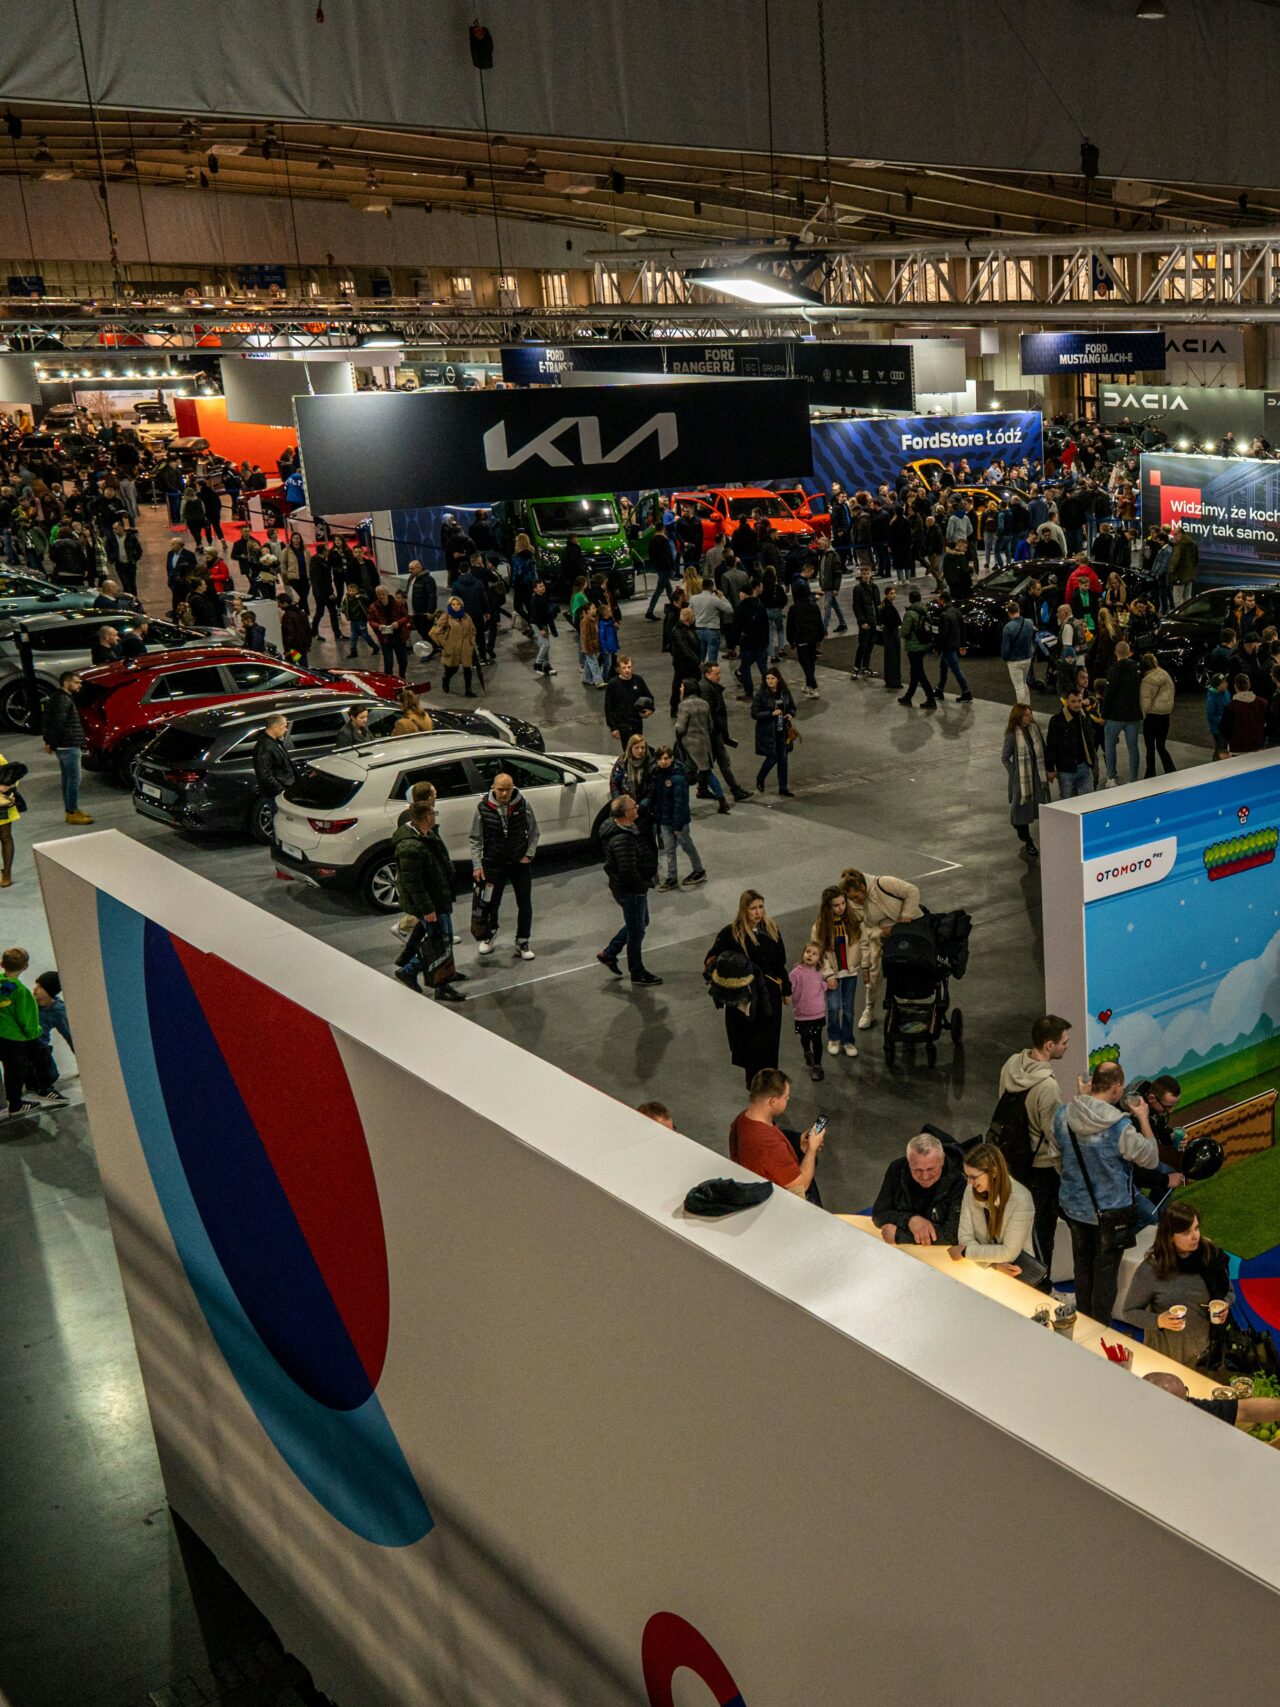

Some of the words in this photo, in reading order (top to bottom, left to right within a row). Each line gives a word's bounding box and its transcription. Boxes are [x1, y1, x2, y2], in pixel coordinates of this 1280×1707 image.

[1085, 343, 1108, 354] FORD
[1165, 338, 1227, 354] ACIA
[546, 349, 565, 361] FORD
[1059, 352, 1100, 365] MUSTANG
[1101, 351, 1133, 364] MACH-E
[538, 360, 574, 374] E-TRANST
[673, 361, 721, 374] RANGER
[1103, 391, 1189, 411] DACIA
[902, 431, 984, 451] FordStore
[986, 427, 1022, 445] Łódź
[1170, 499, 1229, 520] Widzimy,
[1230, 505, 1247, 519] że
[1171, 519, 1209, 538] Mamy
[1212, 524, 1235, 538] tak
[1236, 527, 1279, 542] samo.
[1096, 858, 1152, 882] OTOMOTO
